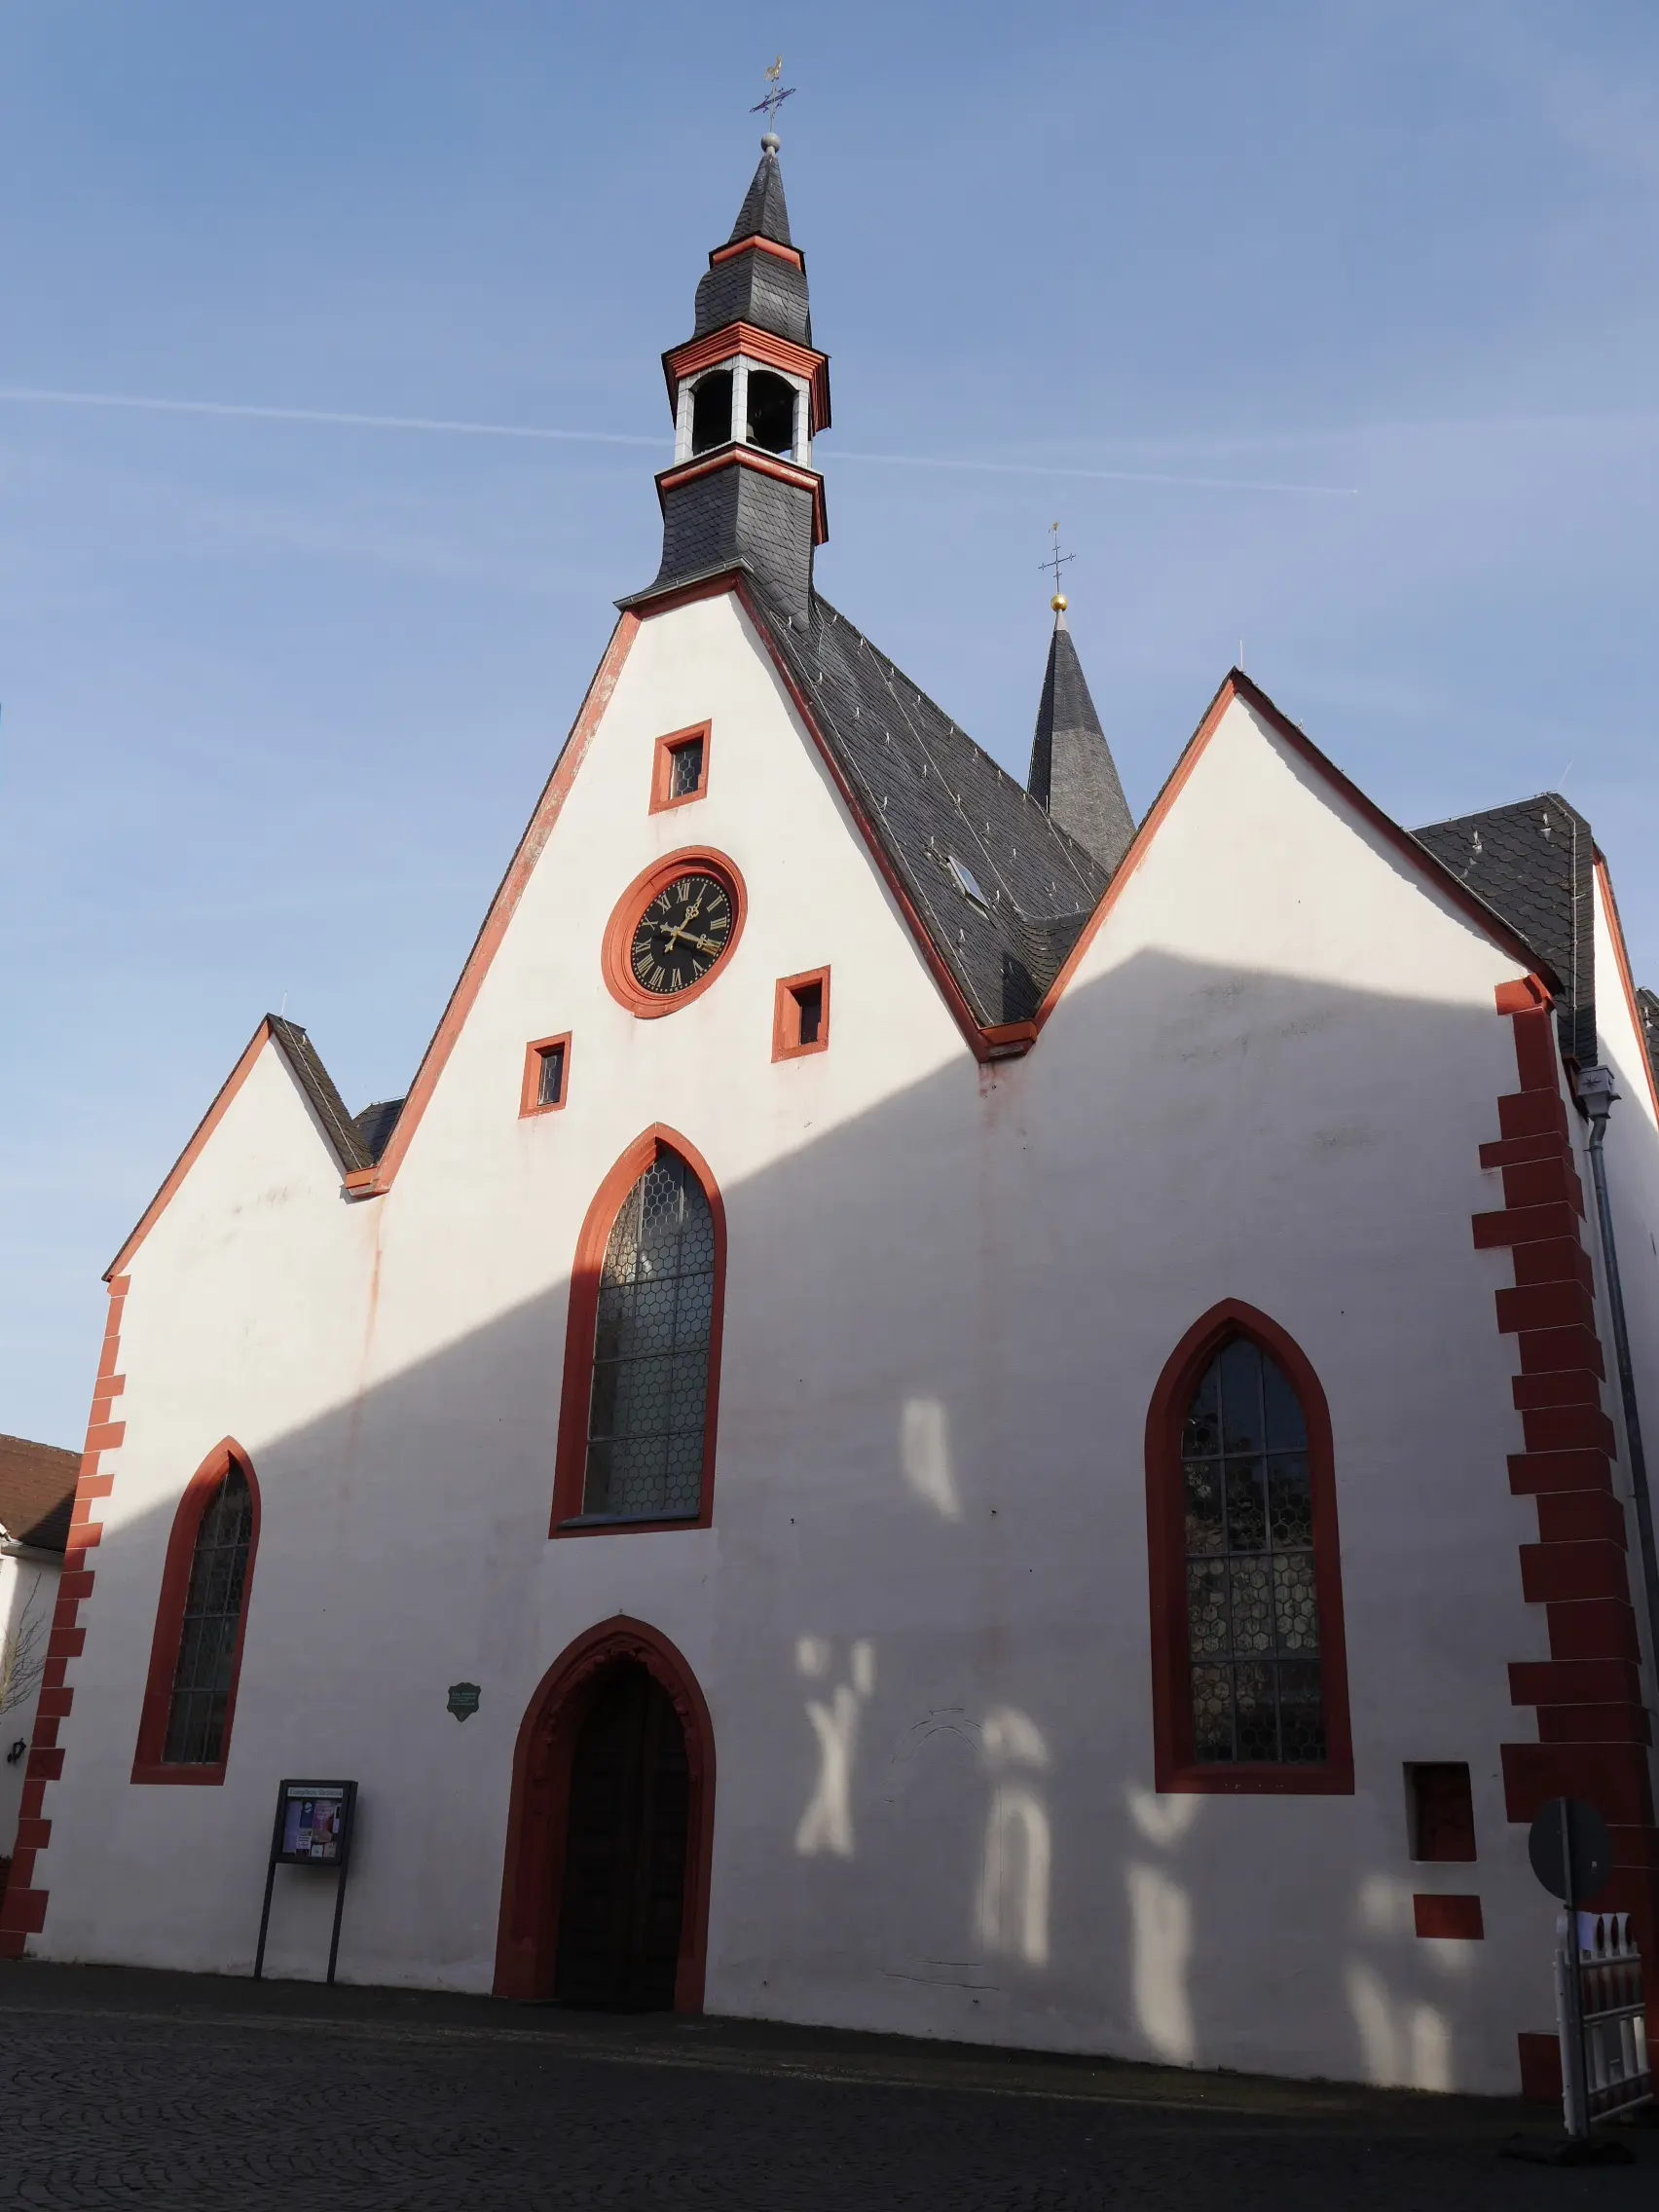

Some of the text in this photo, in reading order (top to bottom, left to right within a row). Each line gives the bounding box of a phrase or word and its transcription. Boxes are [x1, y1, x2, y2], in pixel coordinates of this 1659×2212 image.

[675, 882, 690, 903] XII
[656, 893, 672, 914] XI
[706, 894, 723, 913] II
[642, 916, 658, 931] X
[710, 915, 727, 931] III
[635, 937, 652, 954] IX
[636, 953, 655, 977] VIII
[692, 959, 704, 976] V
[648, 965, 666, 988] VII
[670, 968, 682, 988] VI
